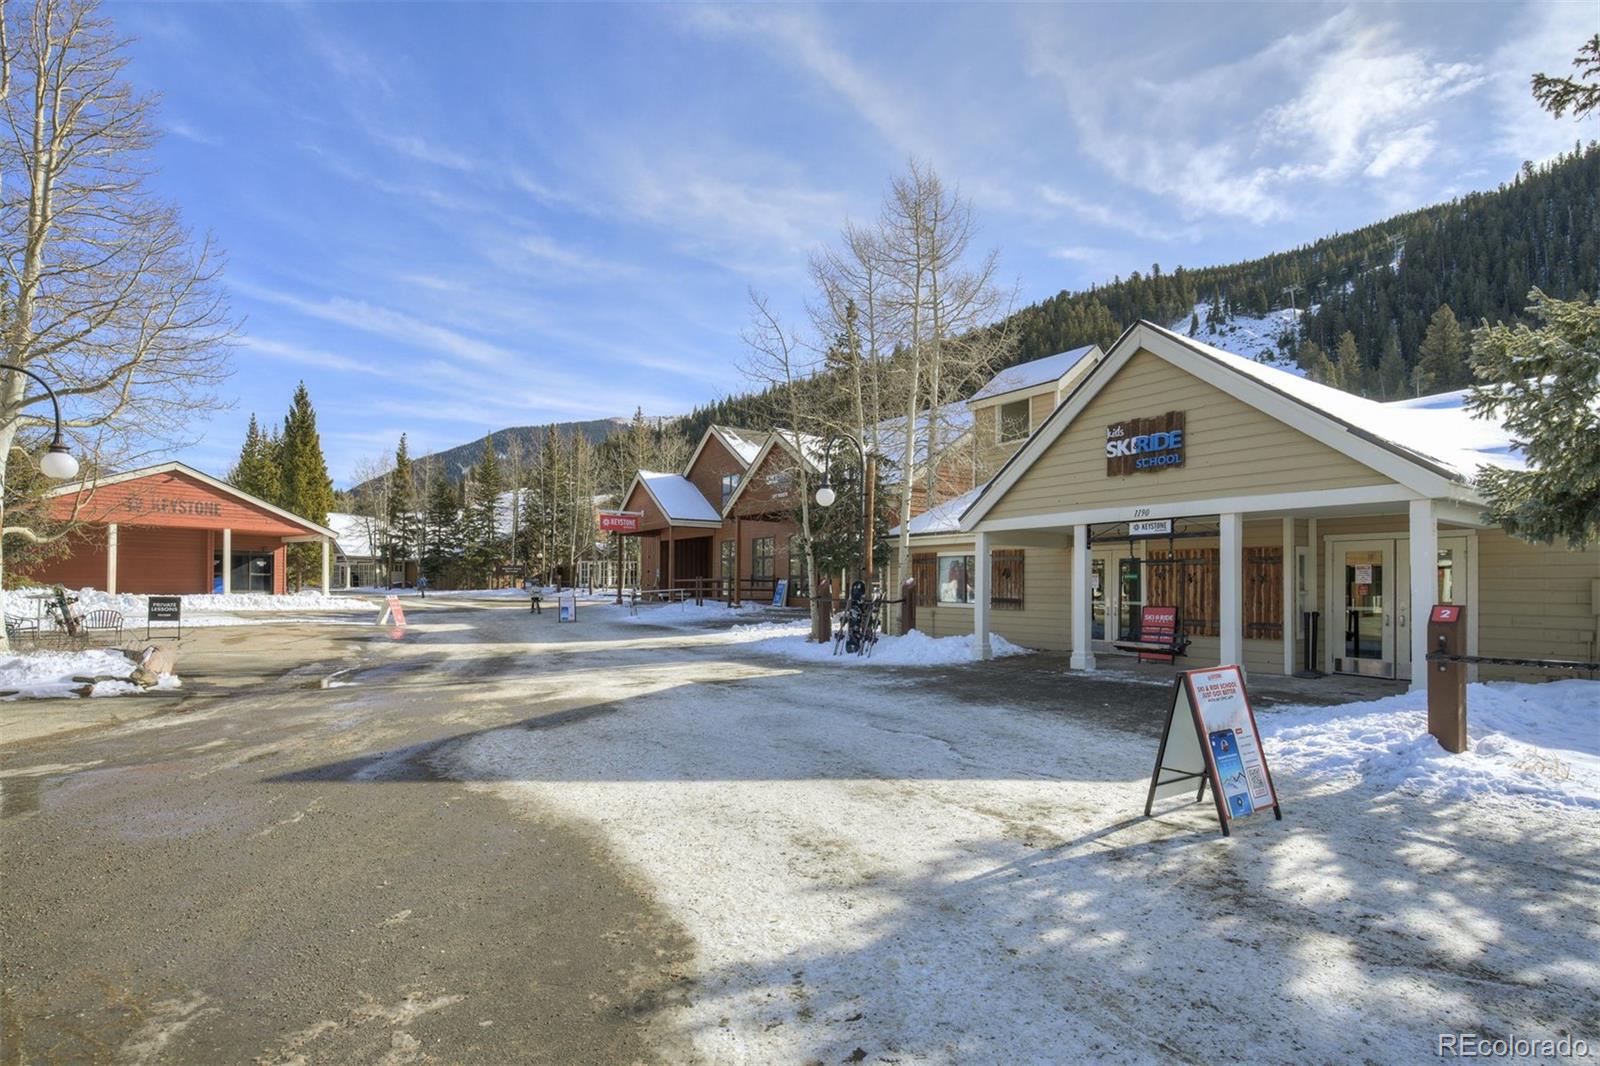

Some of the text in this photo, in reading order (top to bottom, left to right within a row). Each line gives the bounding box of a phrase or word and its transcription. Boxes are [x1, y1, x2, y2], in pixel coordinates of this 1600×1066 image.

[1106, 425, 1125, 439] kids
[1135, 454, 1183, 469] SCHOOL
[151, 497, 222, 516] KEYSTONE
[1134, 508, 1150, 518] 1190
[610, 518, 636, 527] KEYSTONE
[1141, 521, 1167, 530] KEYSTONE
[1439, 609, 1452, 618] 2
